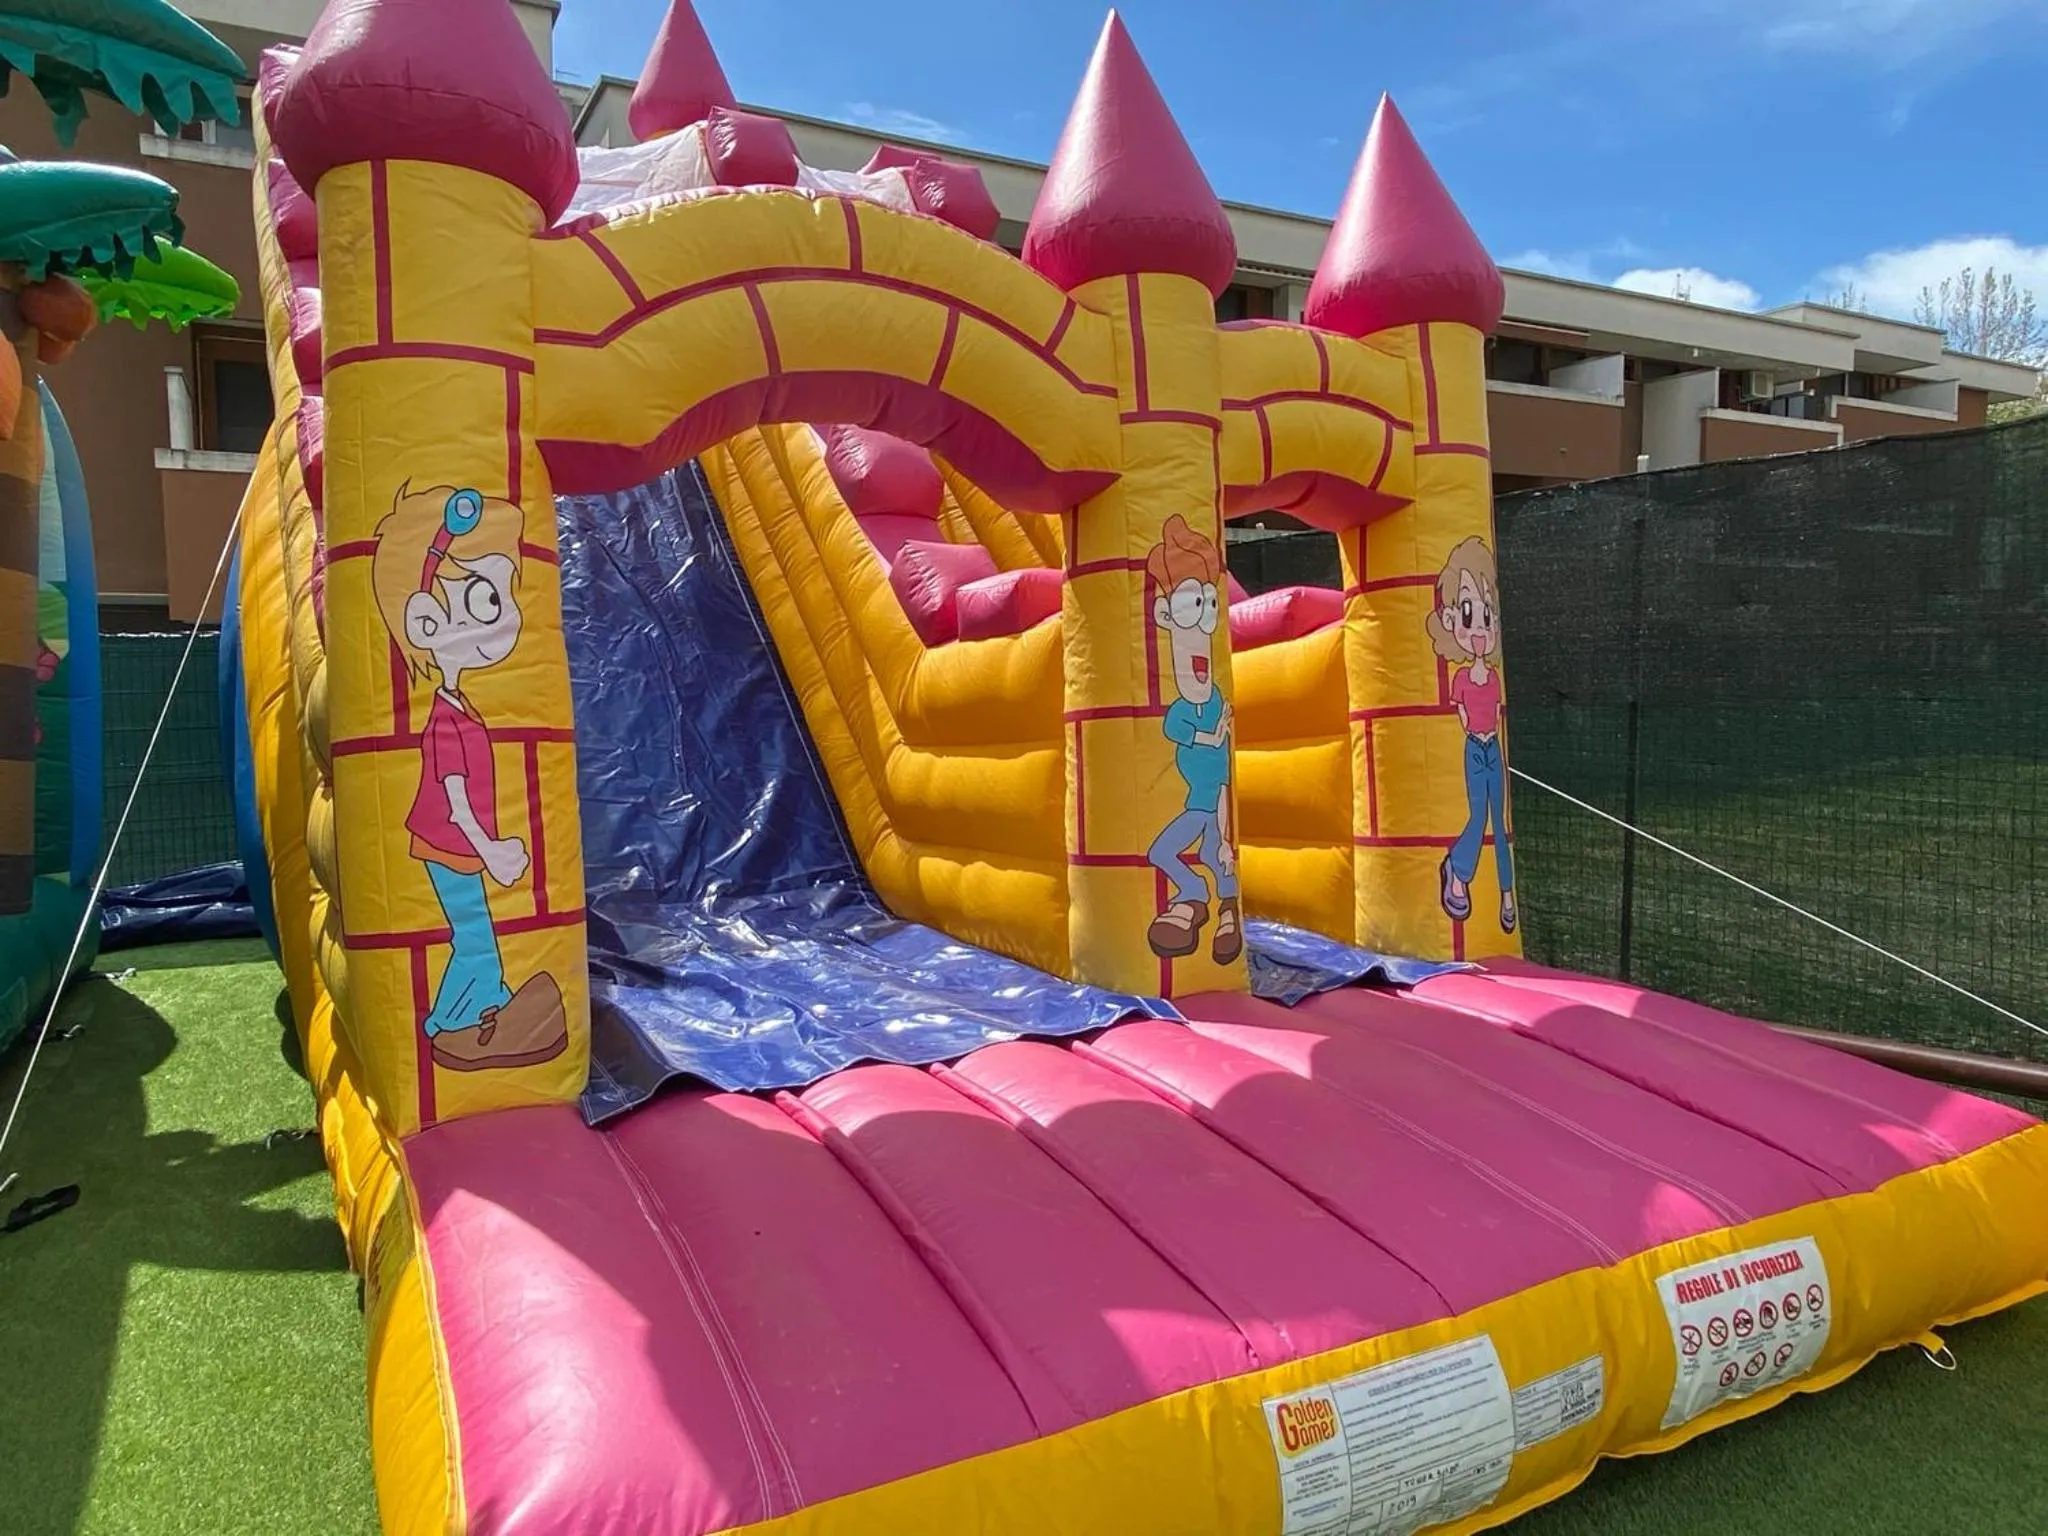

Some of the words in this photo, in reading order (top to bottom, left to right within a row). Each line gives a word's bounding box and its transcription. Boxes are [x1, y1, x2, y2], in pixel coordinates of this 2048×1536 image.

[1676, 1272, 1724, 1304] REGOLE
[1722, 1268, 1741, 1290] DI
[1740, 1249, 1804, 1285] SICUREZZA
[1277, 1397, 1334, 1451] Golden
[1388, 1495, 1417, 1516] 2019
